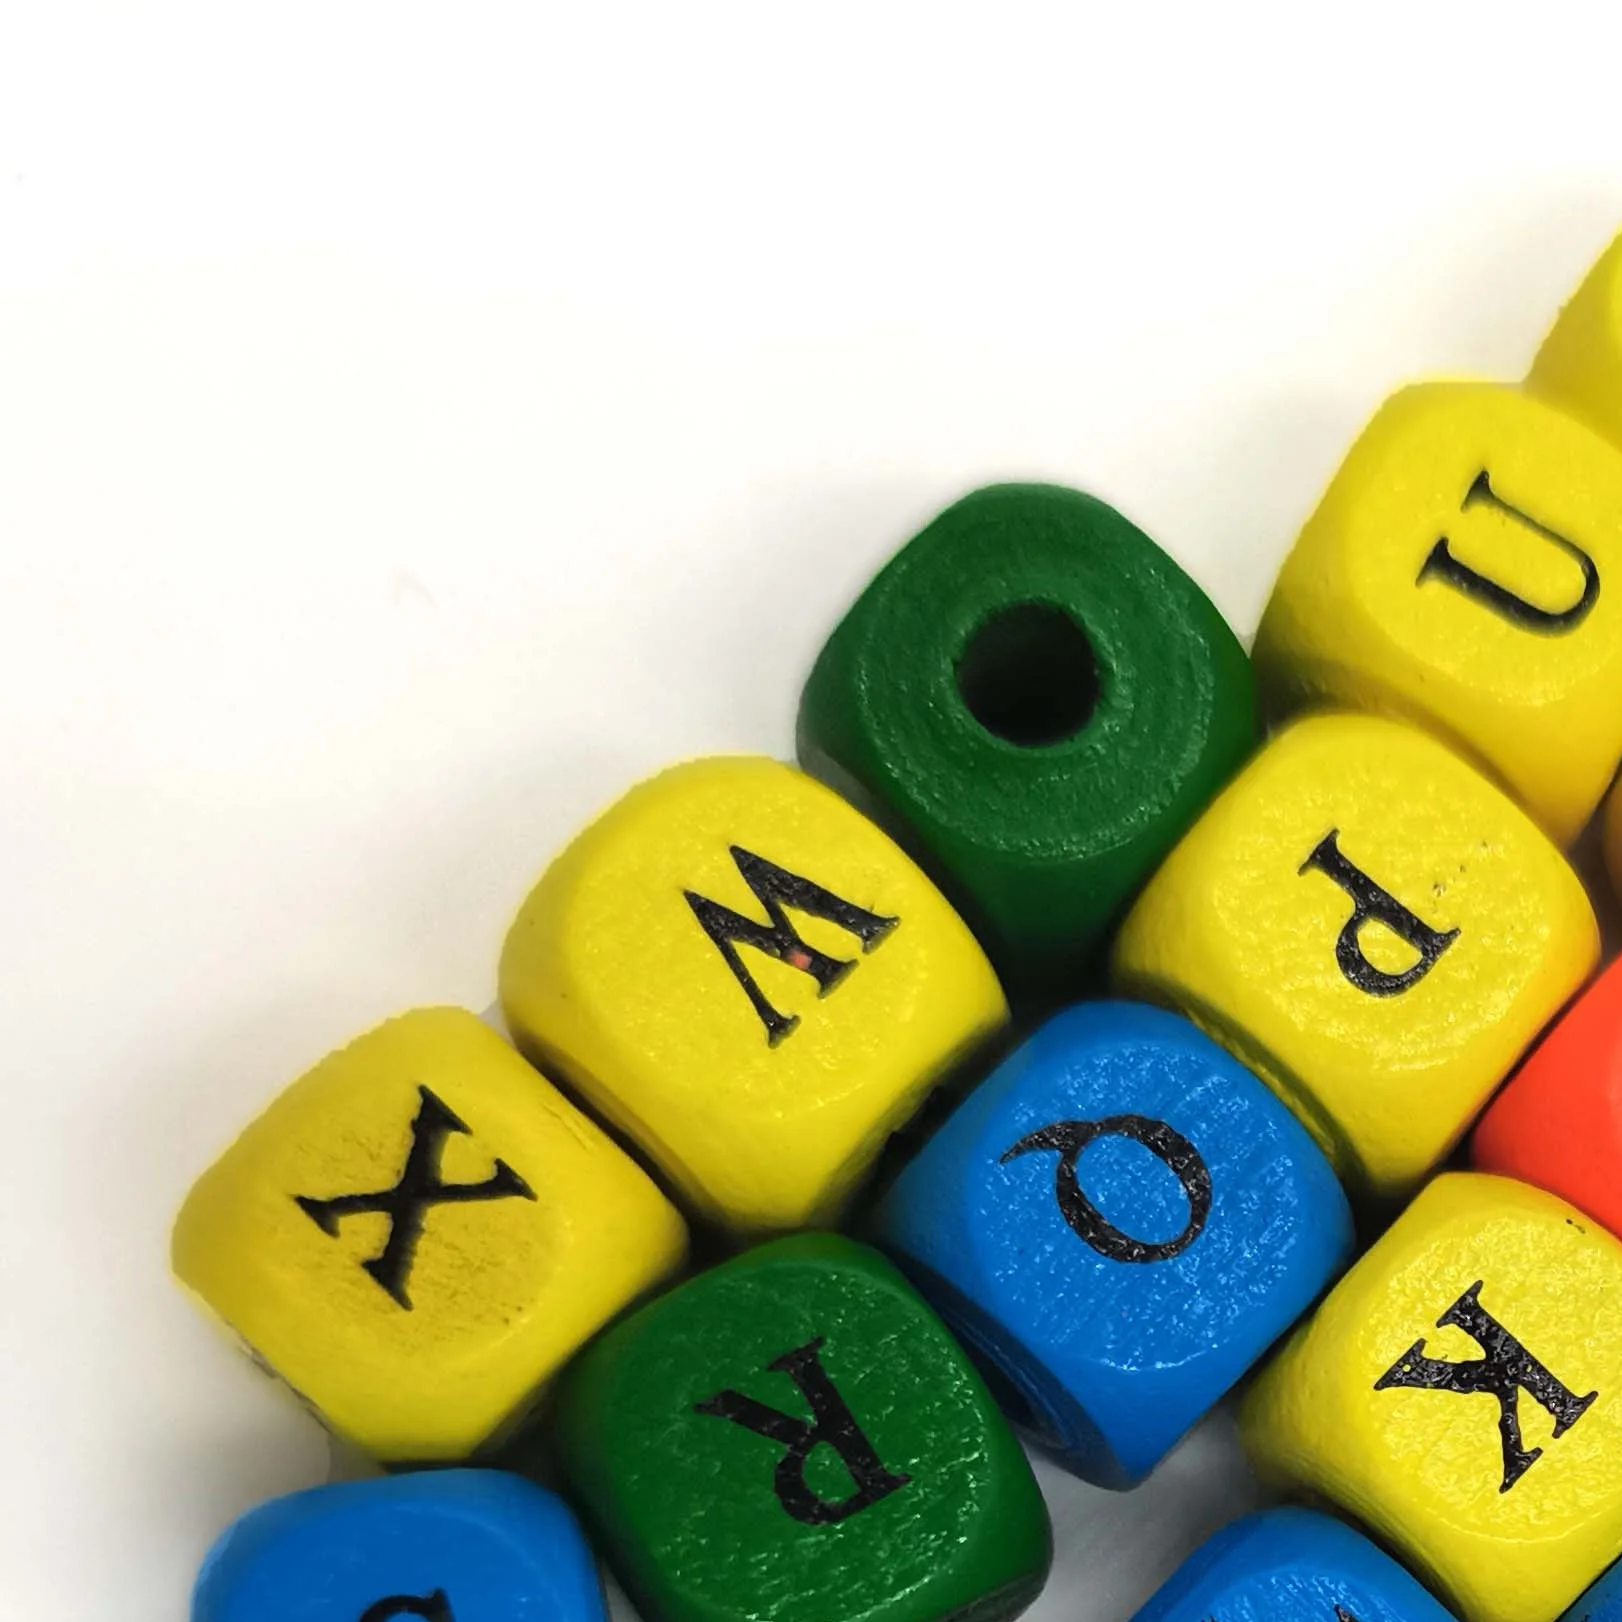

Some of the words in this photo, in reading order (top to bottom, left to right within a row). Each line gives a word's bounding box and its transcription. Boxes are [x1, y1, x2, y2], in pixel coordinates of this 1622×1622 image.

[1415, 467, 1605, 637] U
[682, 844, 901, 1050] W
[1298, 828, 1461, 997] P
[294, 1085, 535, 1310] X
[999, 1113, 1213, 1265] Q
[693, 1336, 911, 1525] R
[1373, 1278, 1600, 1495] K
